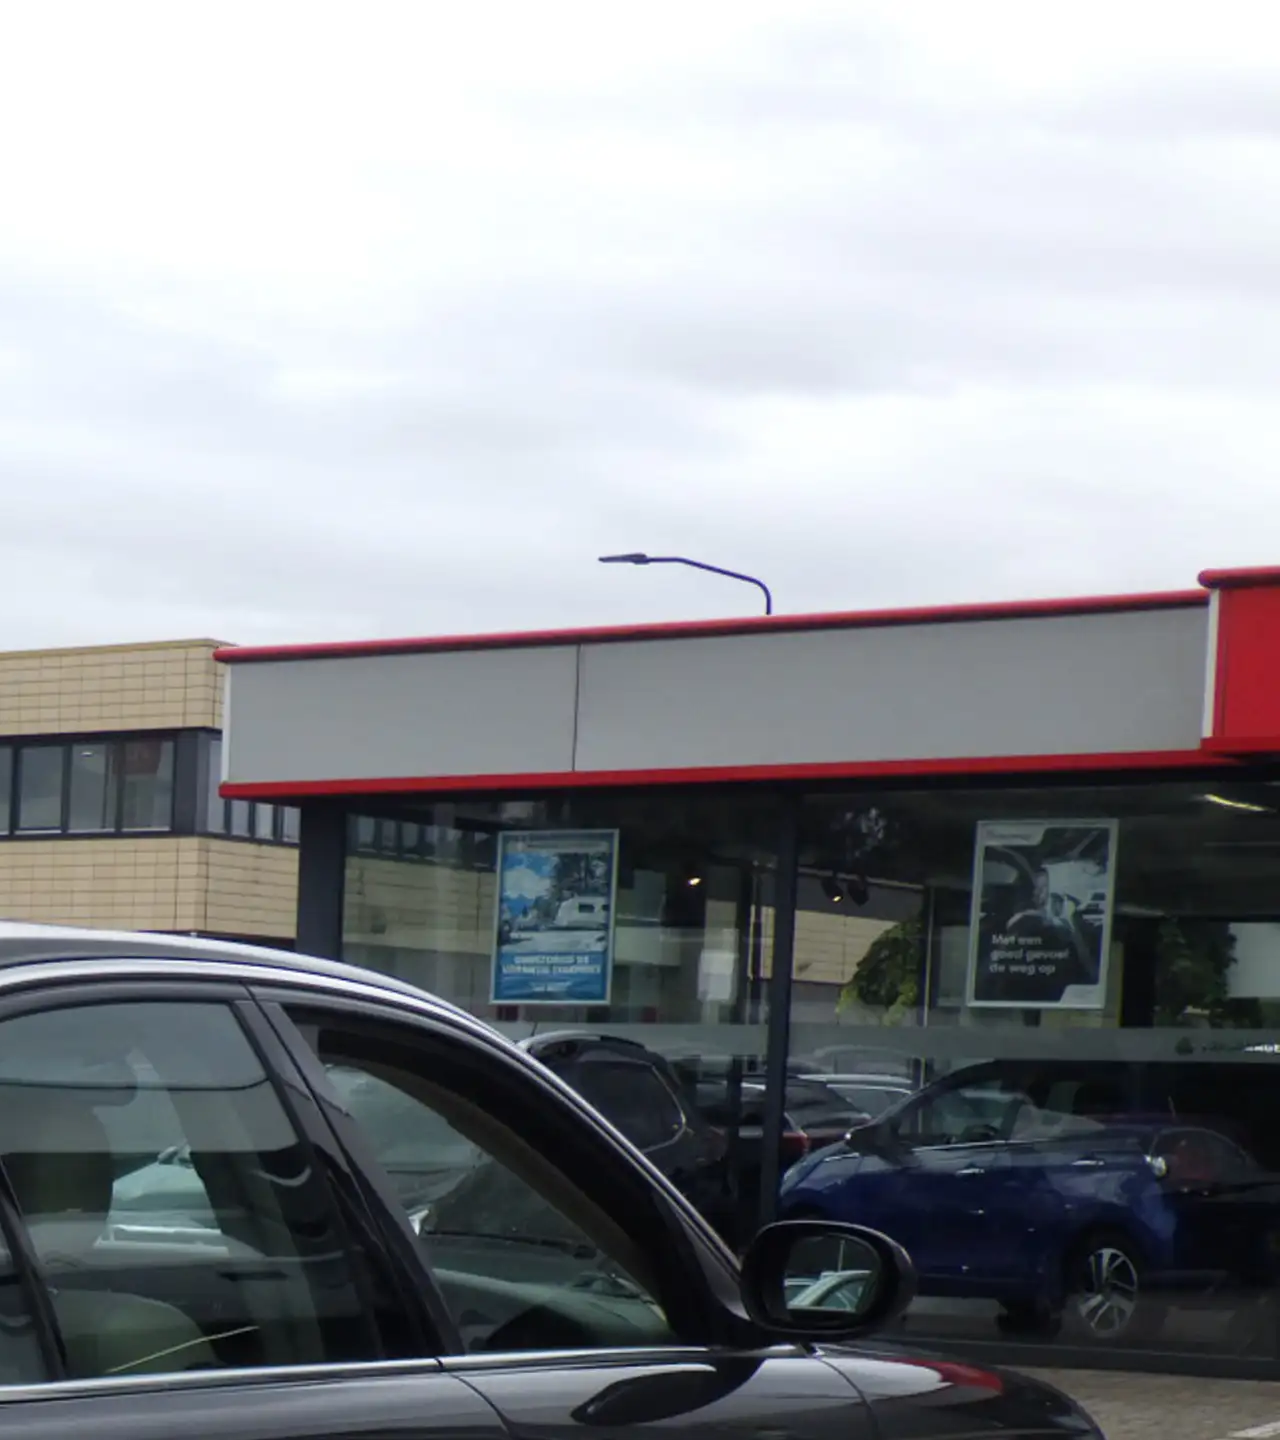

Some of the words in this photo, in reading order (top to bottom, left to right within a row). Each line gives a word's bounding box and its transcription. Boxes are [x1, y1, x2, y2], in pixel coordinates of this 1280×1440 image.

[992, 934, 1015, 945] Met
[989, 963, 1005, 973] de
[1008, 964, 1036, 975] weg
